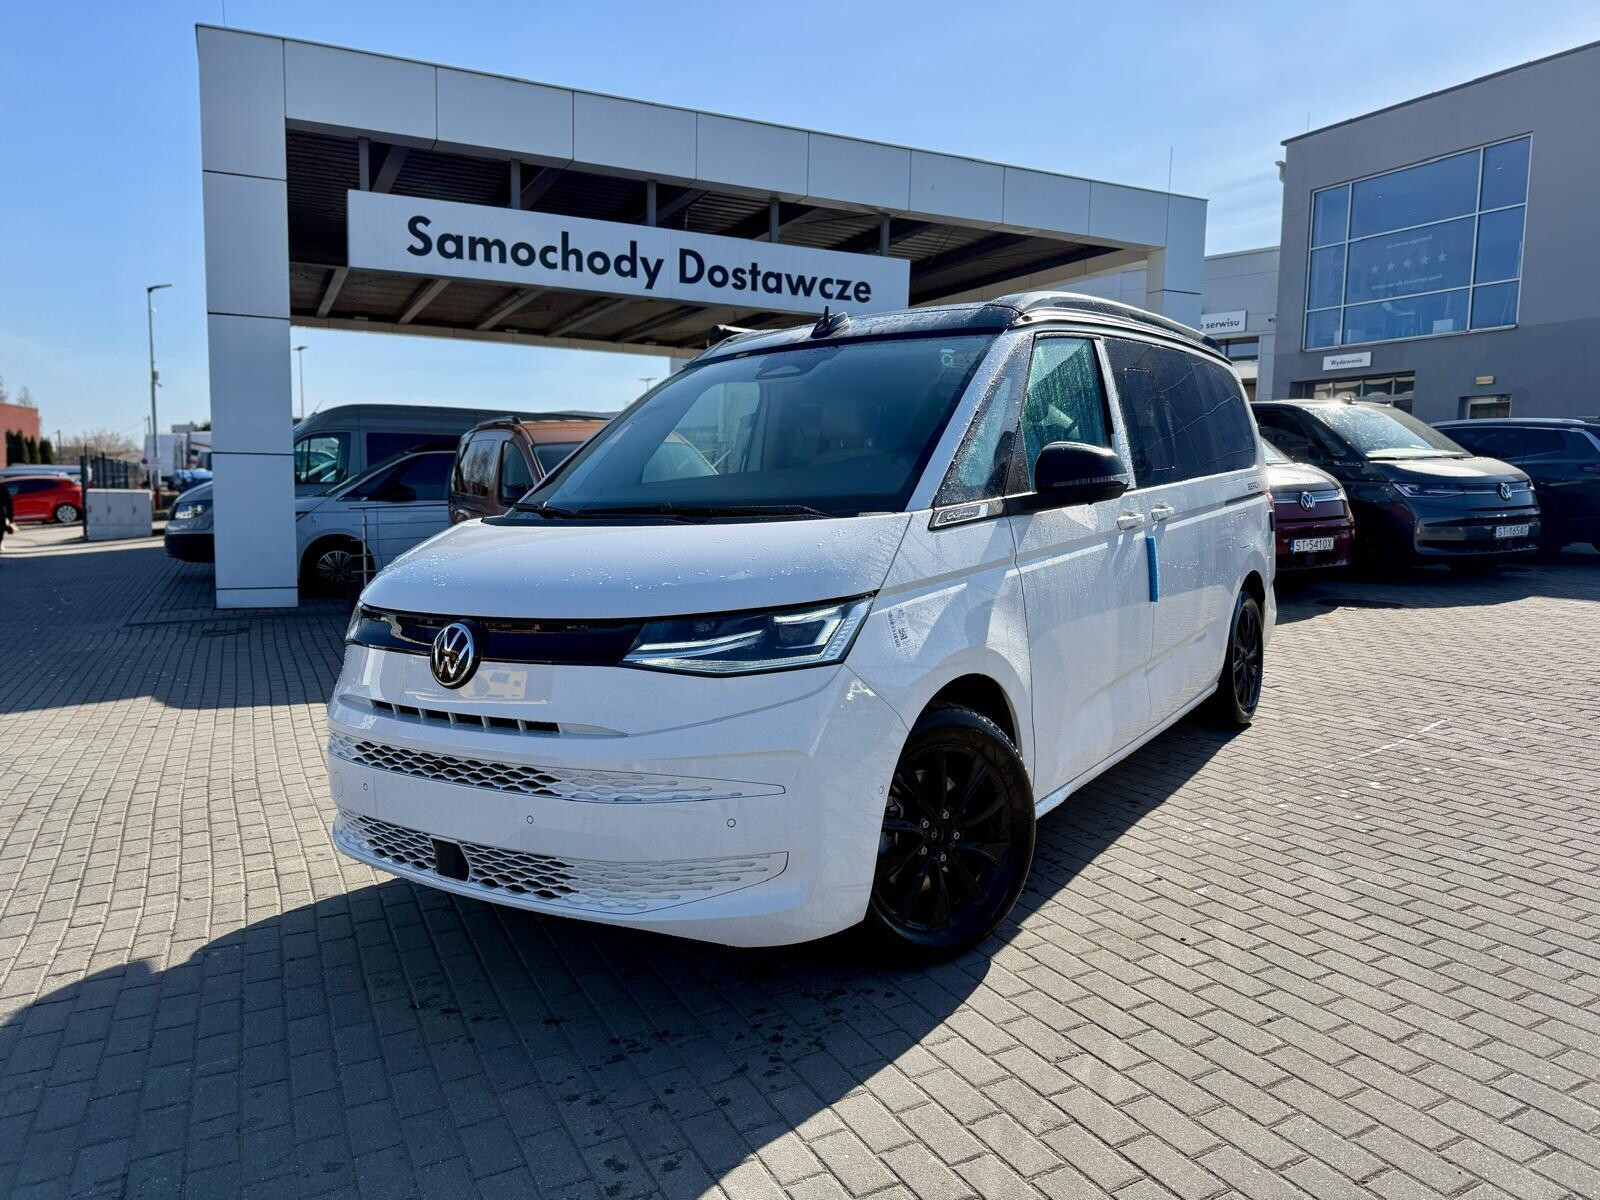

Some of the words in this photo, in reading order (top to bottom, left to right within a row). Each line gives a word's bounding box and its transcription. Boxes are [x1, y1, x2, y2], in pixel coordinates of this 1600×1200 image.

[406, 215, 664, 290] Samochody
[679, 249, 872, 303] Dostawcze
[1206, 318, 1240, 329] serwisu
